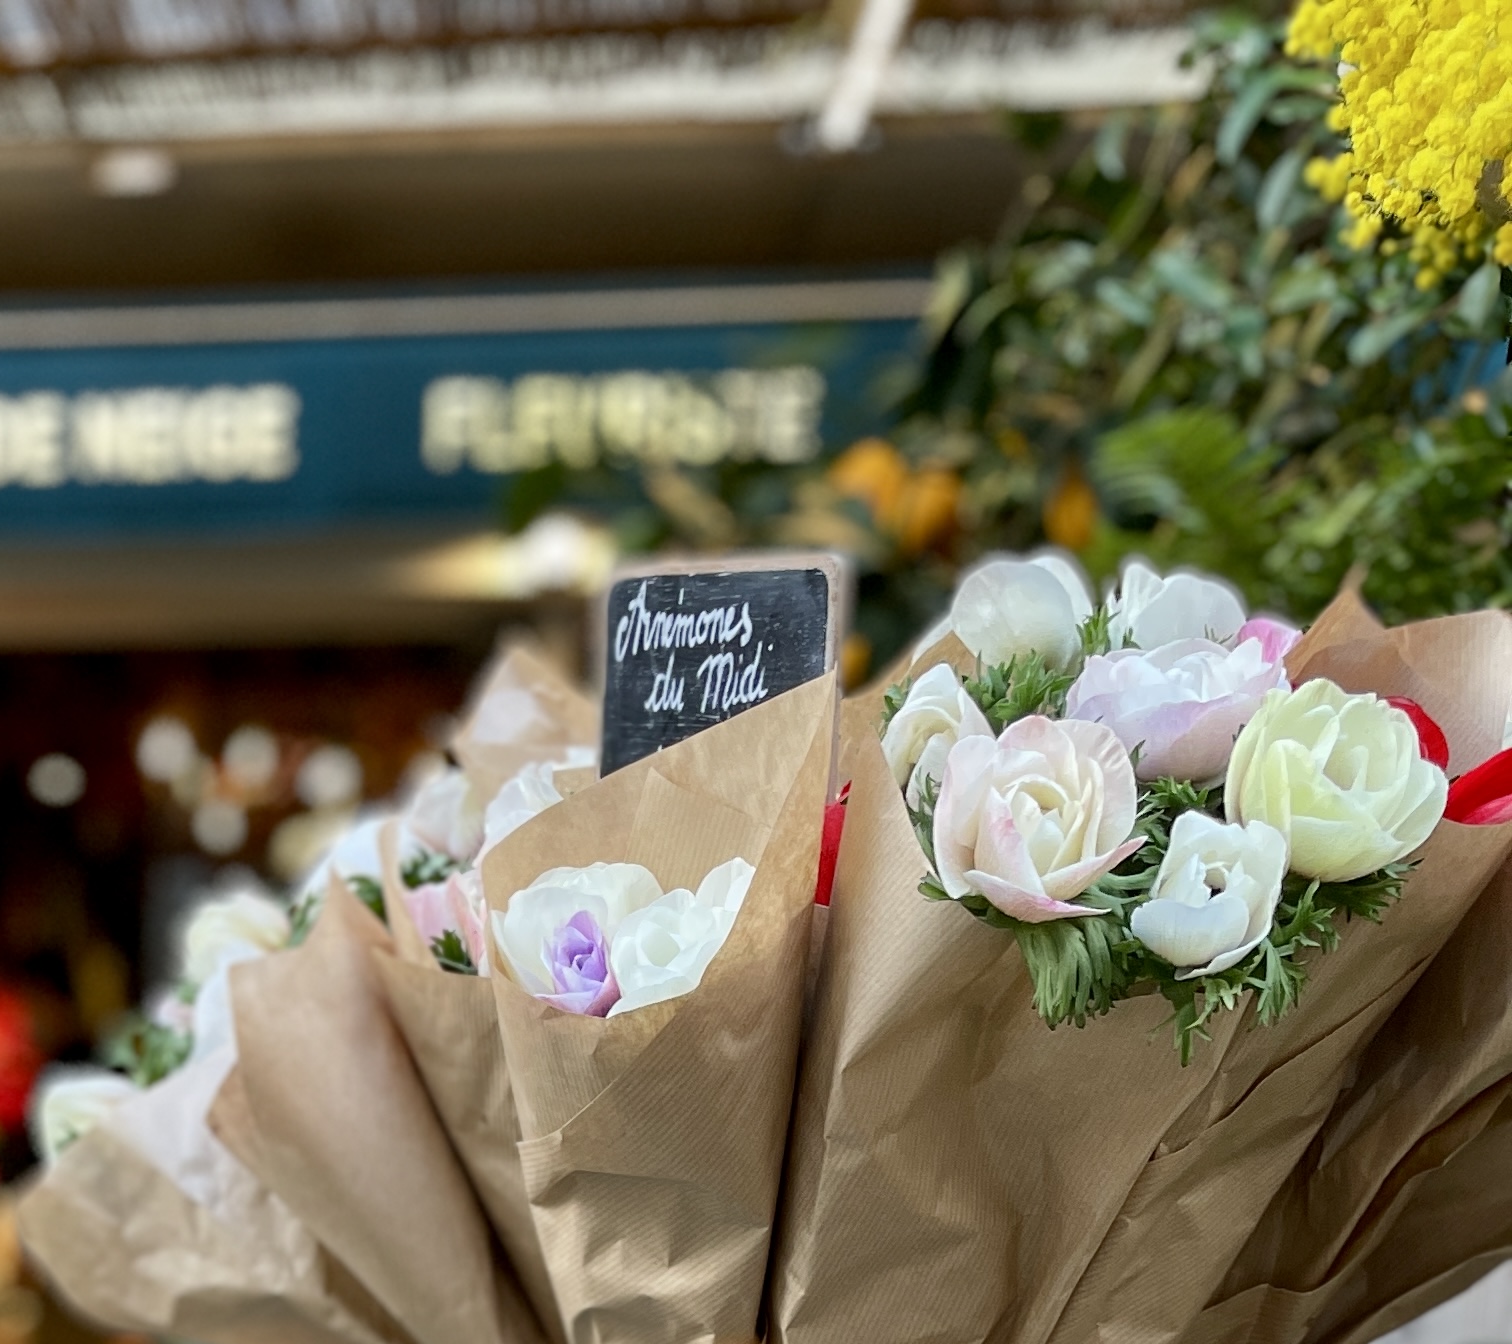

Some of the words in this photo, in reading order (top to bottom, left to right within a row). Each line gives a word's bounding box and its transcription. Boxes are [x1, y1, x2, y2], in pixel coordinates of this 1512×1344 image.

[72, 382, 300, 485] NEIGE
[644, 651, 685, 713] du
[696, 641, 774, 714] Midi
